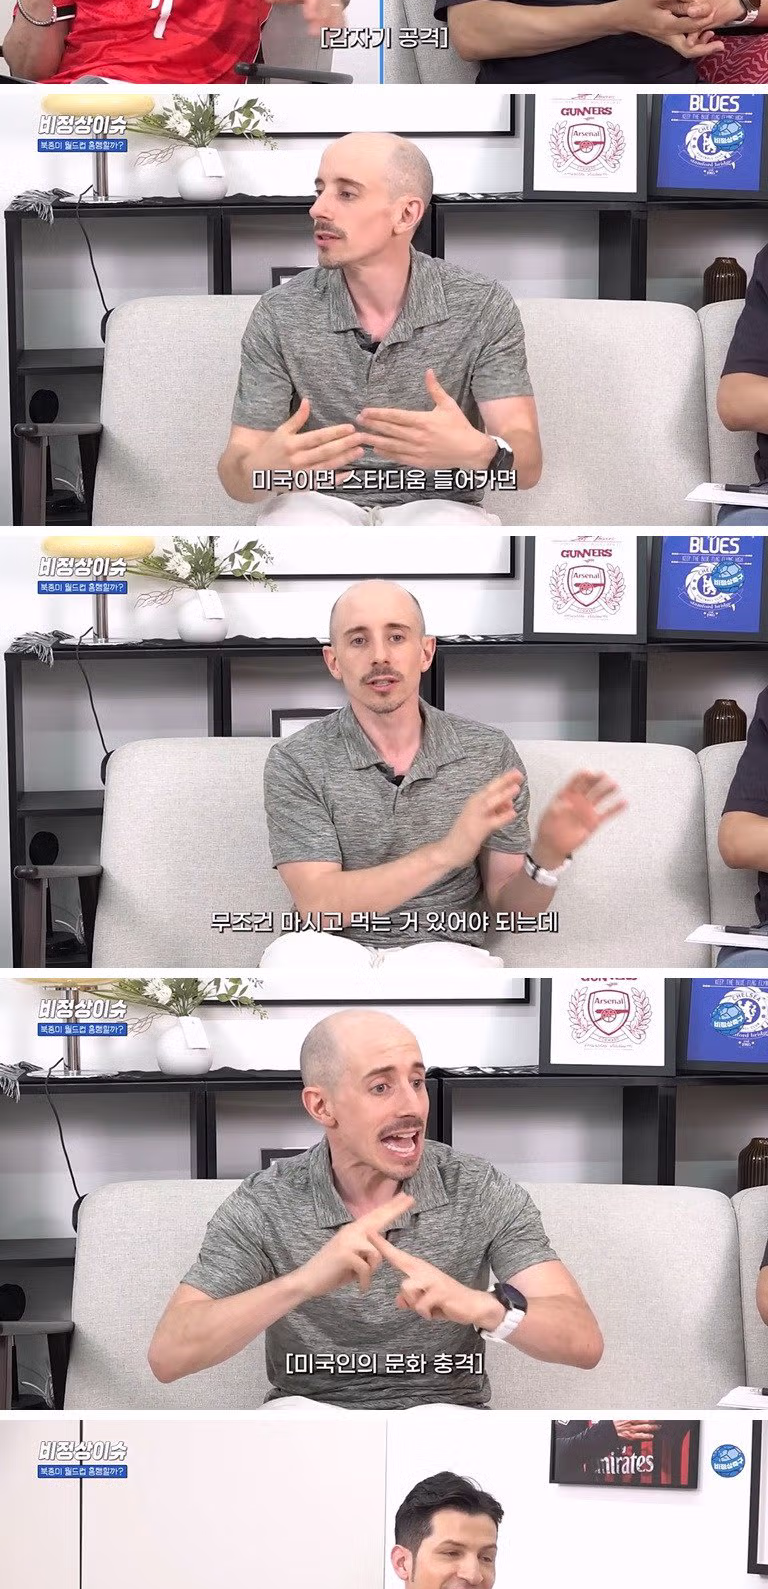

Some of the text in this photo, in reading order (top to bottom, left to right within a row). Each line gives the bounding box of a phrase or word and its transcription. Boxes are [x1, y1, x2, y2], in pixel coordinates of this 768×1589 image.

[689, 95, 740, 112] BLUES
[560, 107, 613, 116] GUNNERS
[594, 997, 625, 1005] Arsenal
[732, 992, 761, 1002] CHELSEA
